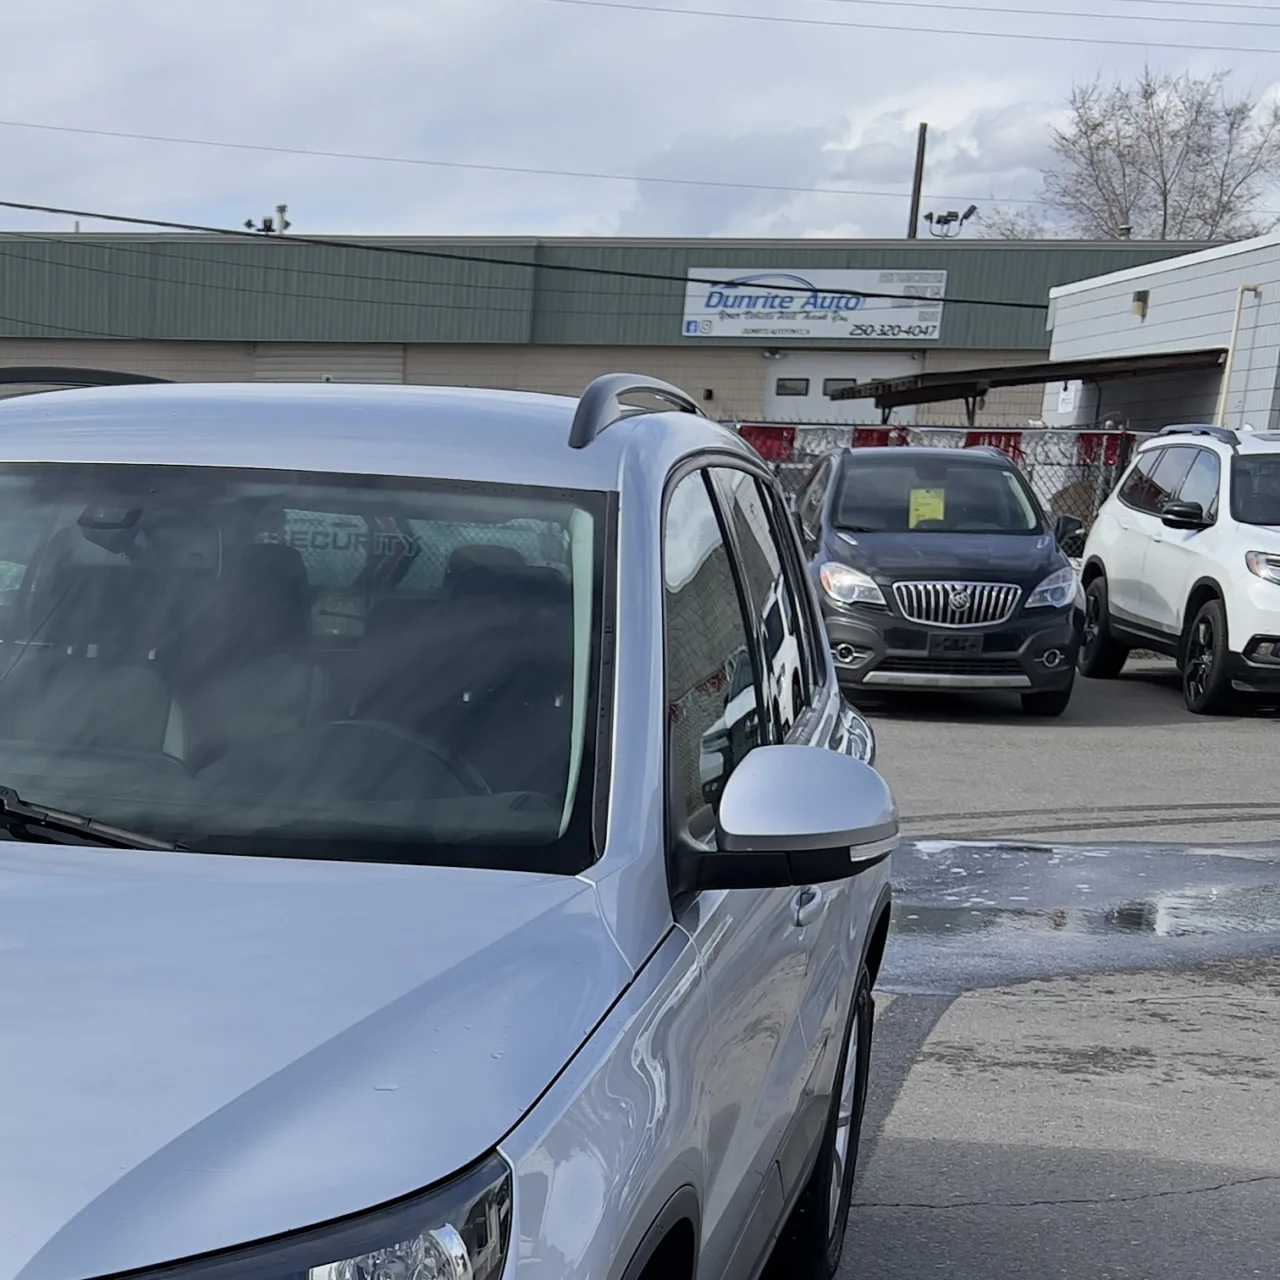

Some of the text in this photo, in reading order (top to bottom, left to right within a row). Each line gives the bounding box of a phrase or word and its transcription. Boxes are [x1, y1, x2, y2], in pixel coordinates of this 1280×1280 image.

[704, 289, 861, 310] Dunrite Auto
[848, 324, 938, 337] 250-320-4047
